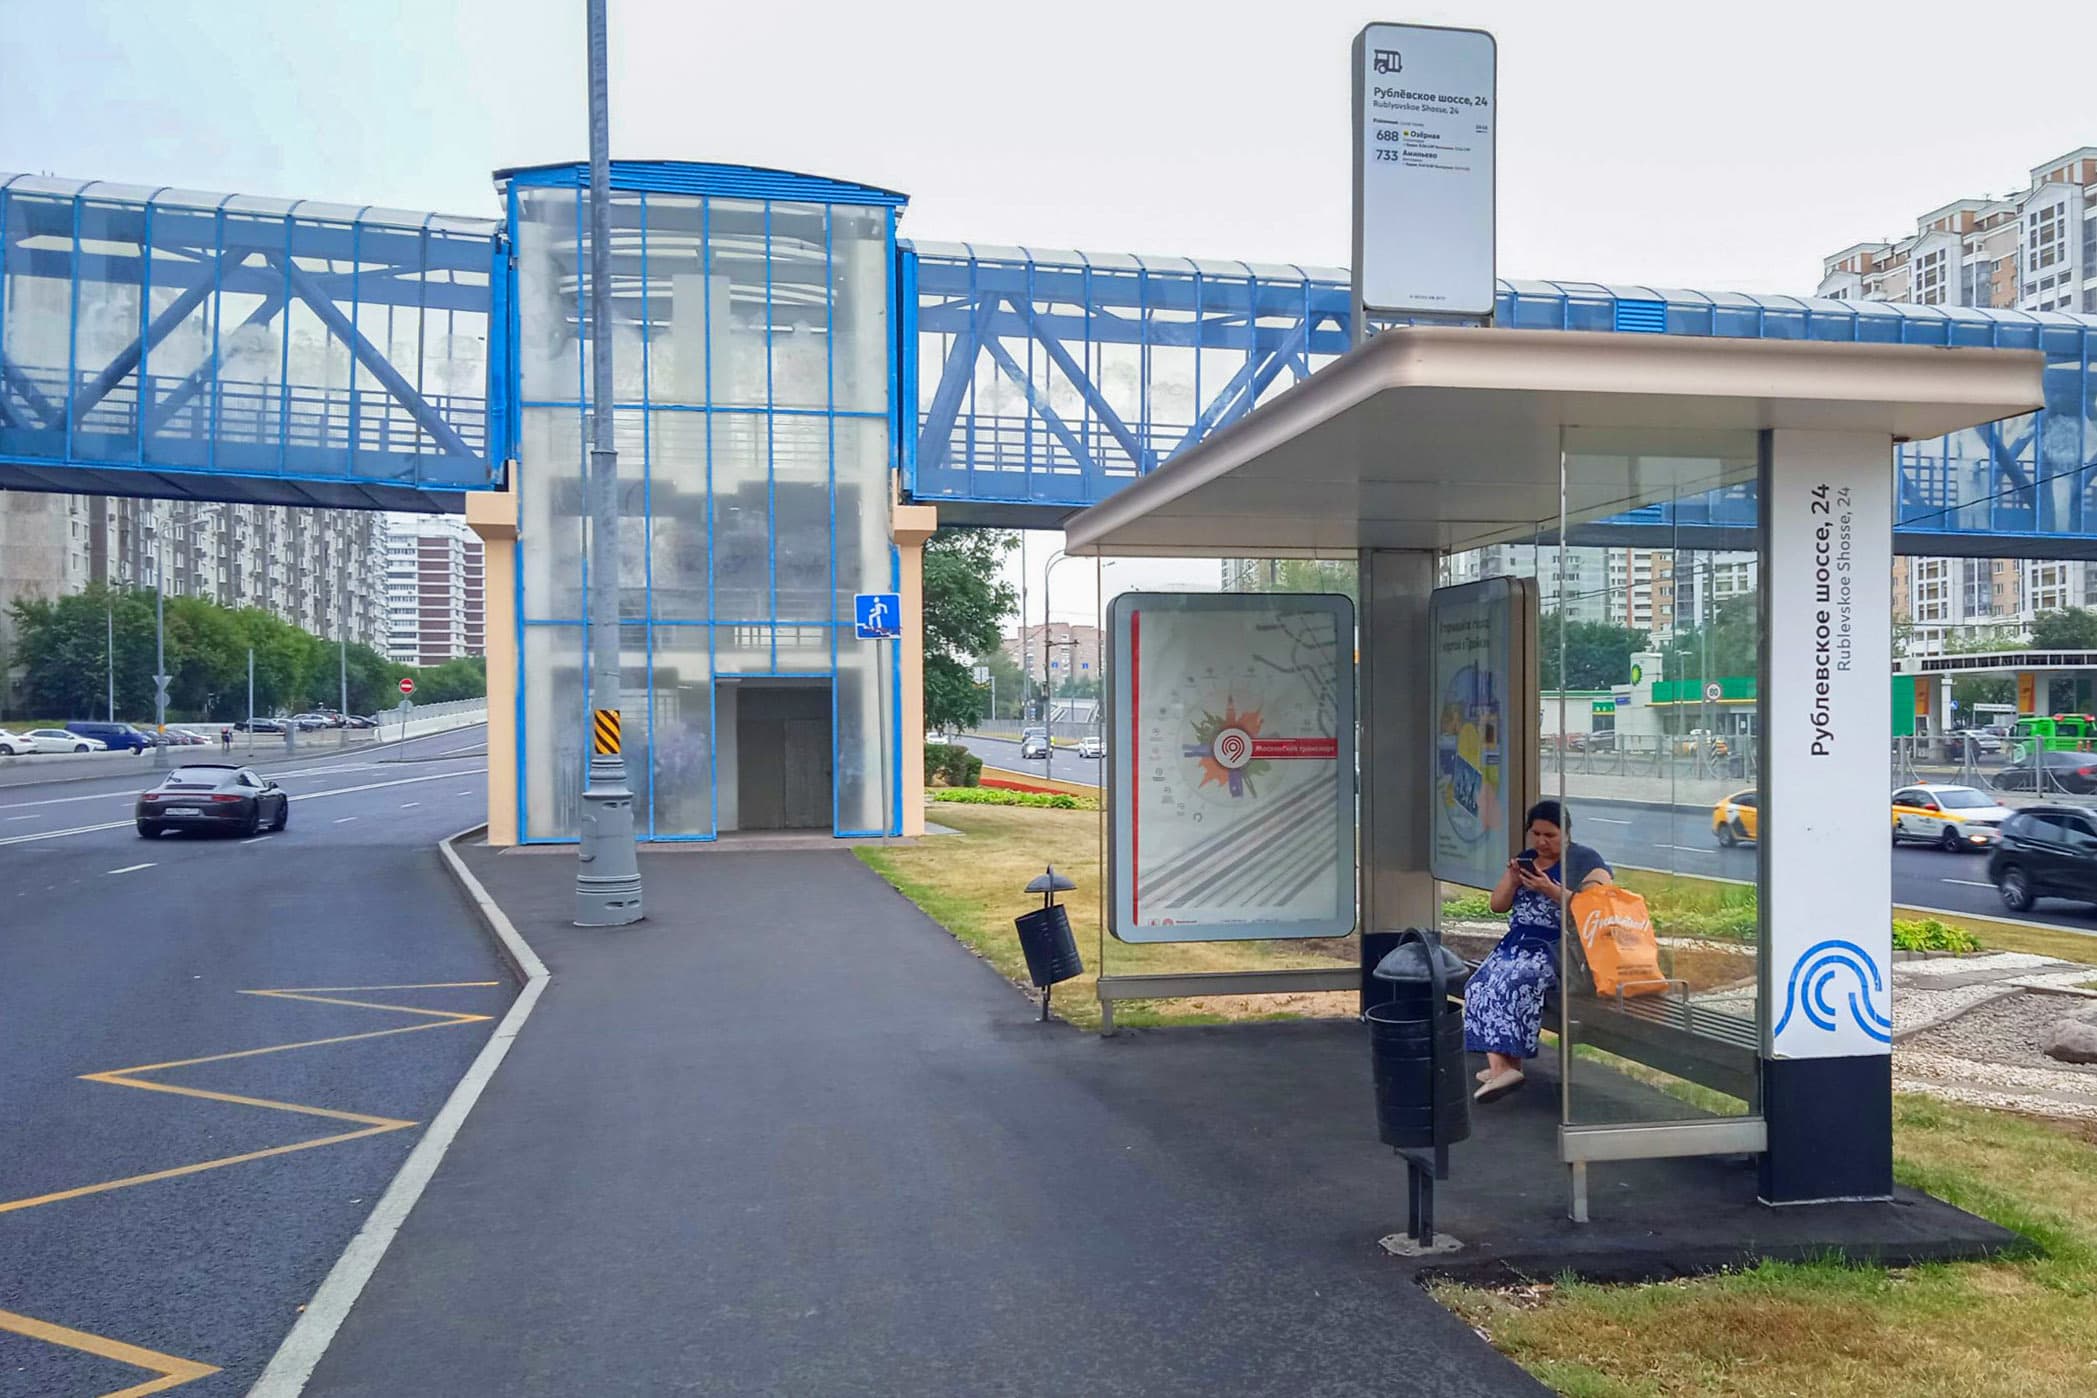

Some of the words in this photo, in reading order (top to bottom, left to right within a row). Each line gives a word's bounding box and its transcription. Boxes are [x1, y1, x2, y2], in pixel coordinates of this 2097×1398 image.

[1374, 87, 1436, 101] Рублёвское
[1438, 95, 1473, 106] шоссе,
[1475, 96, 1488, 106] 24
[1373, 100, 1420, 110] Rublyovskoe
[1421, 104, 1448, 114] Shosse,
[1376, 130, 1399, 142] 688
[1410, 131, 1440, 140] Озёрная
[1376, 149, 1399, 161] 733
[1811, 483, 1830, 515] 24
[1837, 486, 1851, 506] 24
[1837, 511, 1853, 574] Shosse,
[1814, 521, 1833, 602] шоссе,
[1837, 577, 1851, 671] Rublevskoe
[1811, 609, 1834, 756] Рублевское
